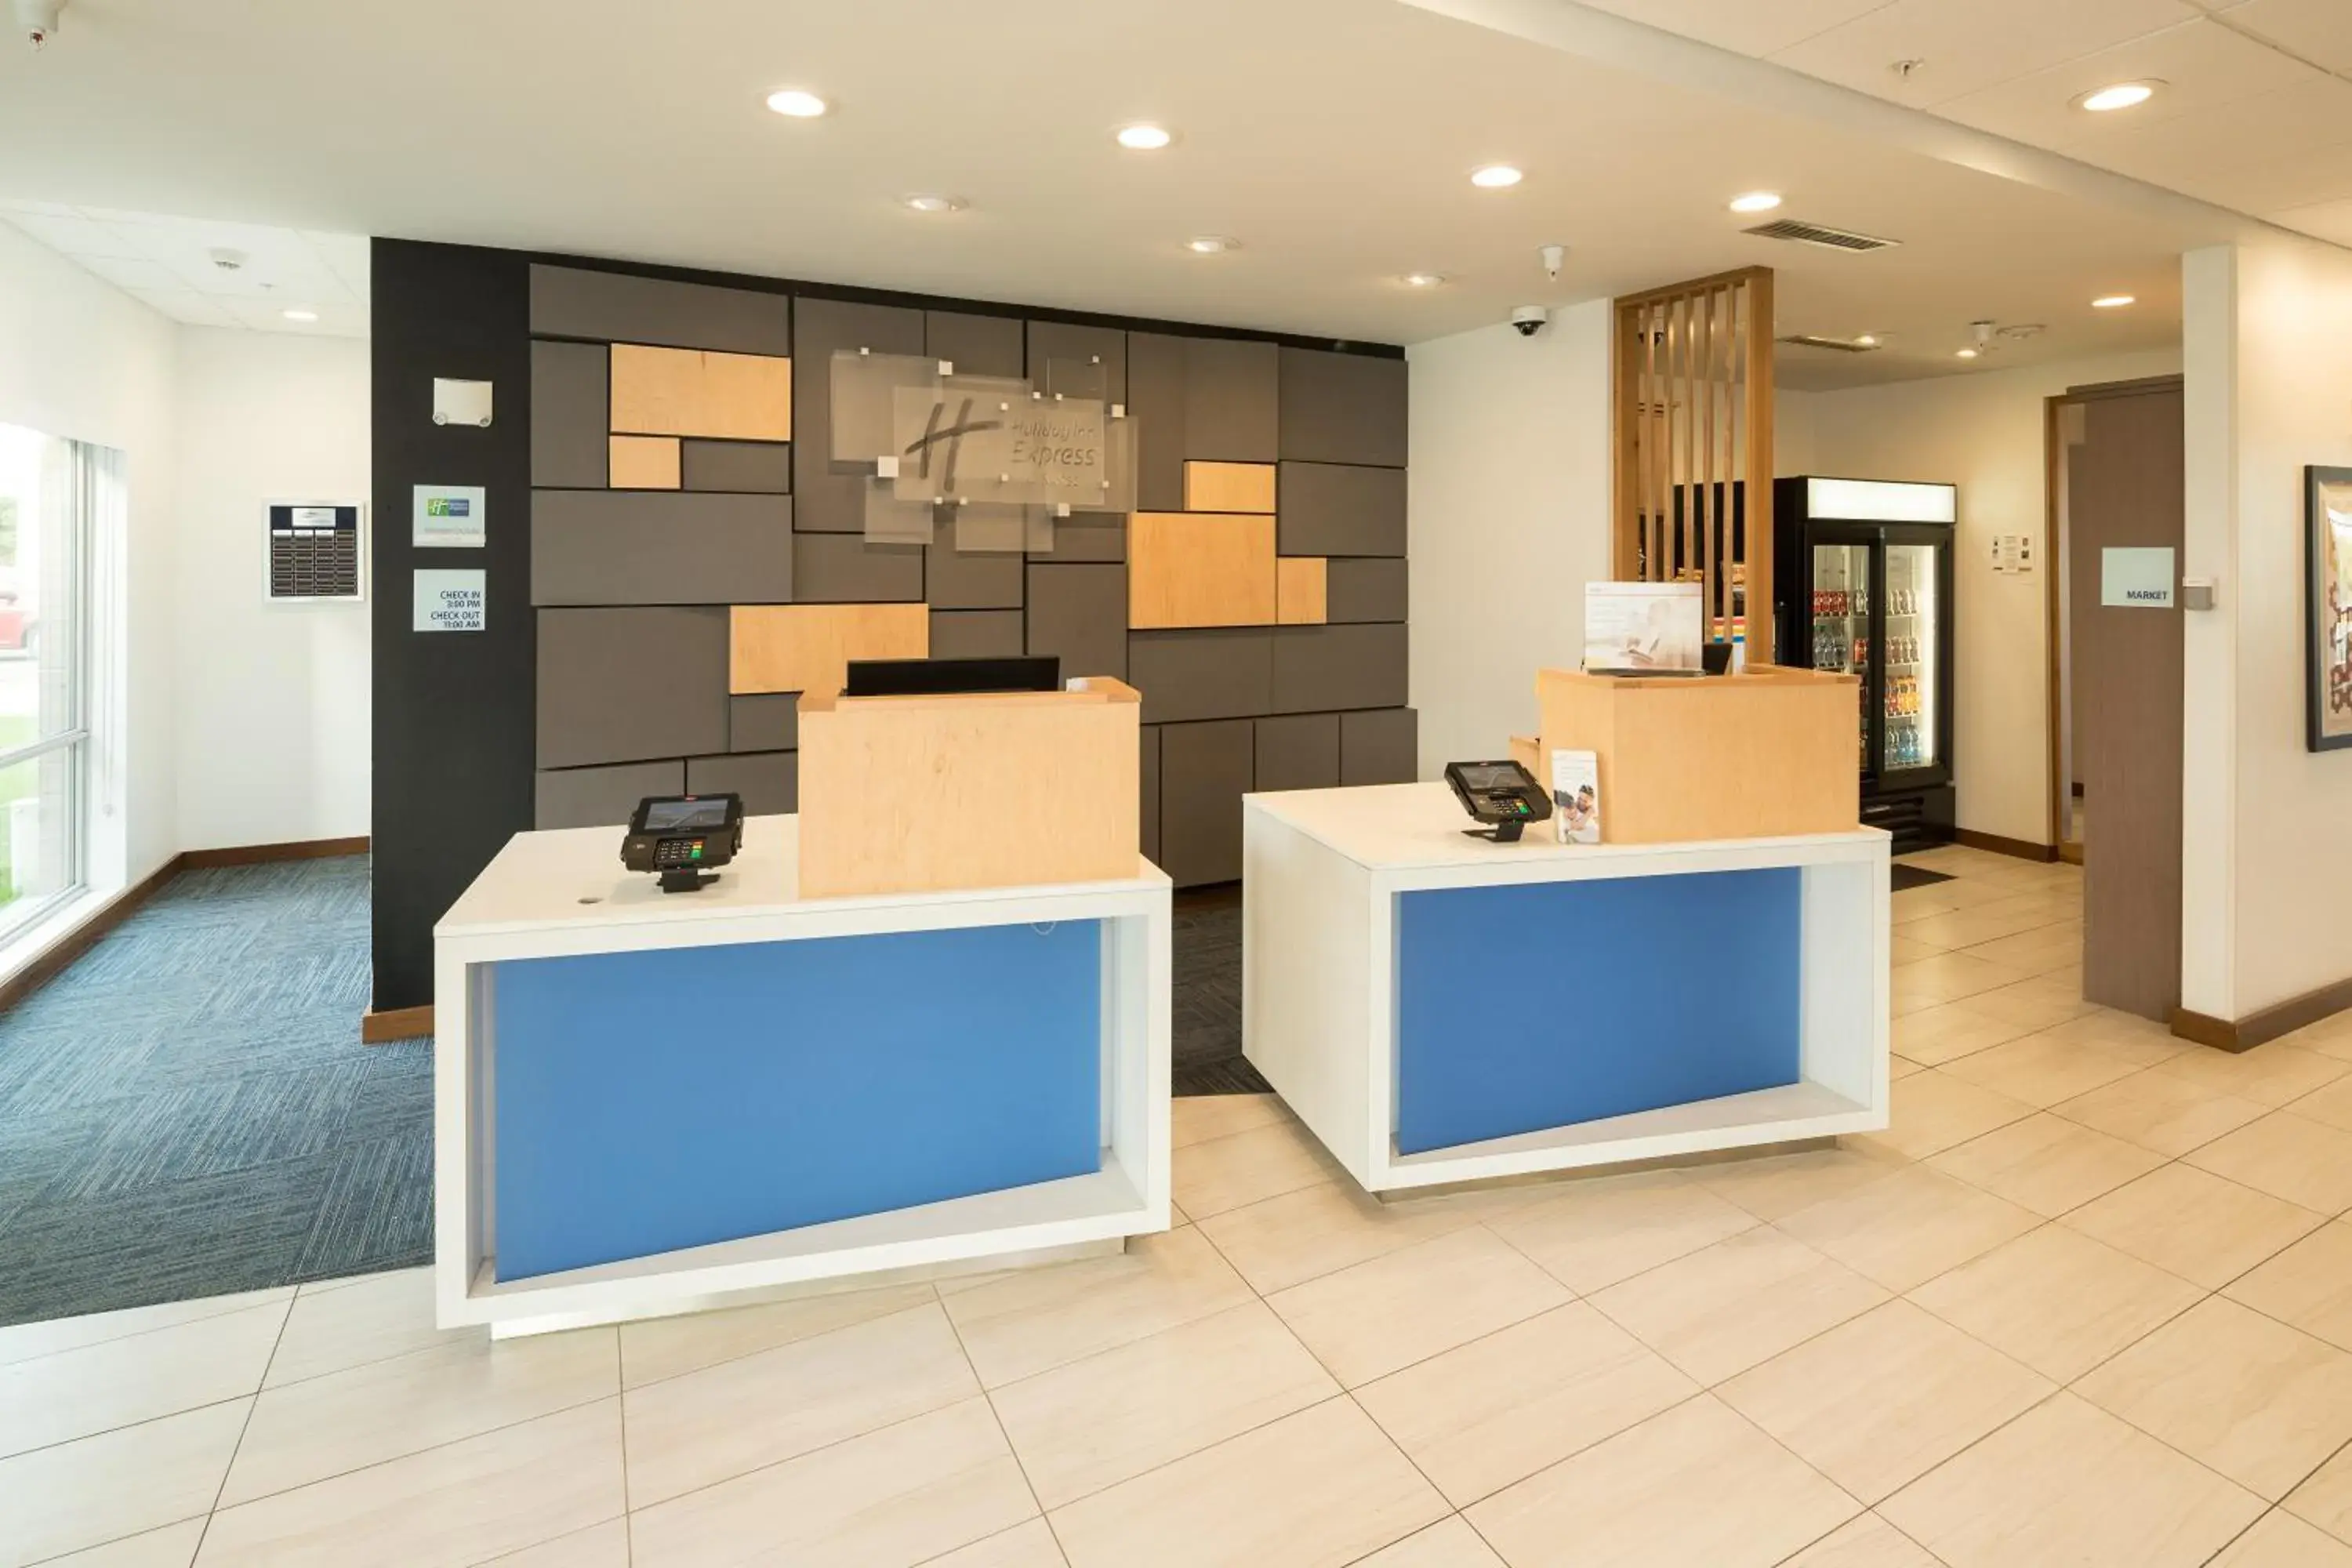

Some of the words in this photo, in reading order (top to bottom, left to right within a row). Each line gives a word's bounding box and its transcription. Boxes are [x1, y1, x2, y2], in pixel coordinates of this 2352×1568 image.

[1011, 440, 1095, 468] Express
[440, 590, 469, 599] CHECK
[471, 590, 481, 599] IN
[2127, 590, 2167, 600] MARKET
[447, 600, 465, 608] 3:00
[466, 600, 481, 608] PM
[430, 611, 459, 620] CHECK
[461, 611, 481, 619] OUT
